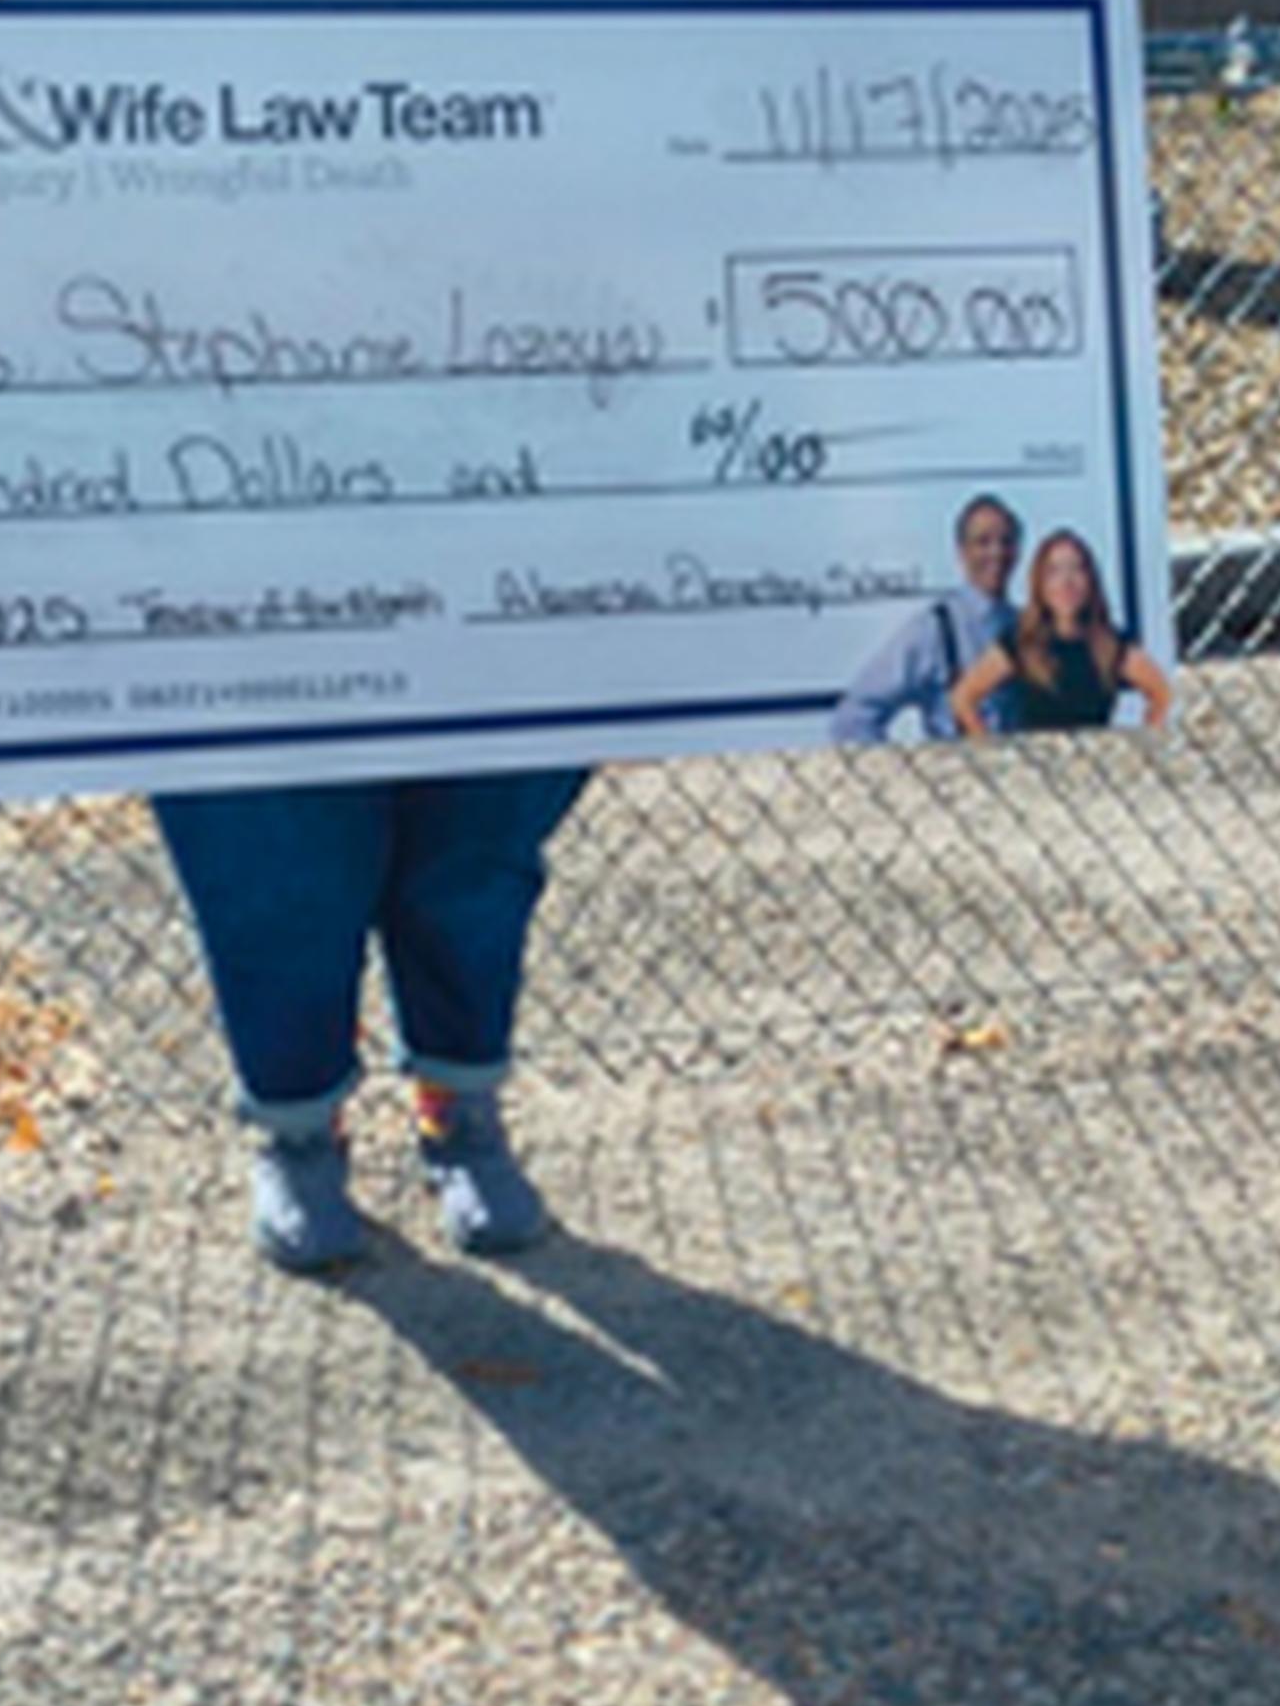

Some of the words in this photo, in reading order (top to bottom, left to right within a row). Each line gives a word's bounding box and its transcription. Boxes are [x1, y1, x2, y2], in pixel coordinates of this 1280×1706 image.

[47, 82, 206, 145] Wife
[216, 80, 361, 144] Law
[363, 80, 544, 140] Team
[304, 155, 412, 191] Death
[166, 432, 395, 512] Dollars
